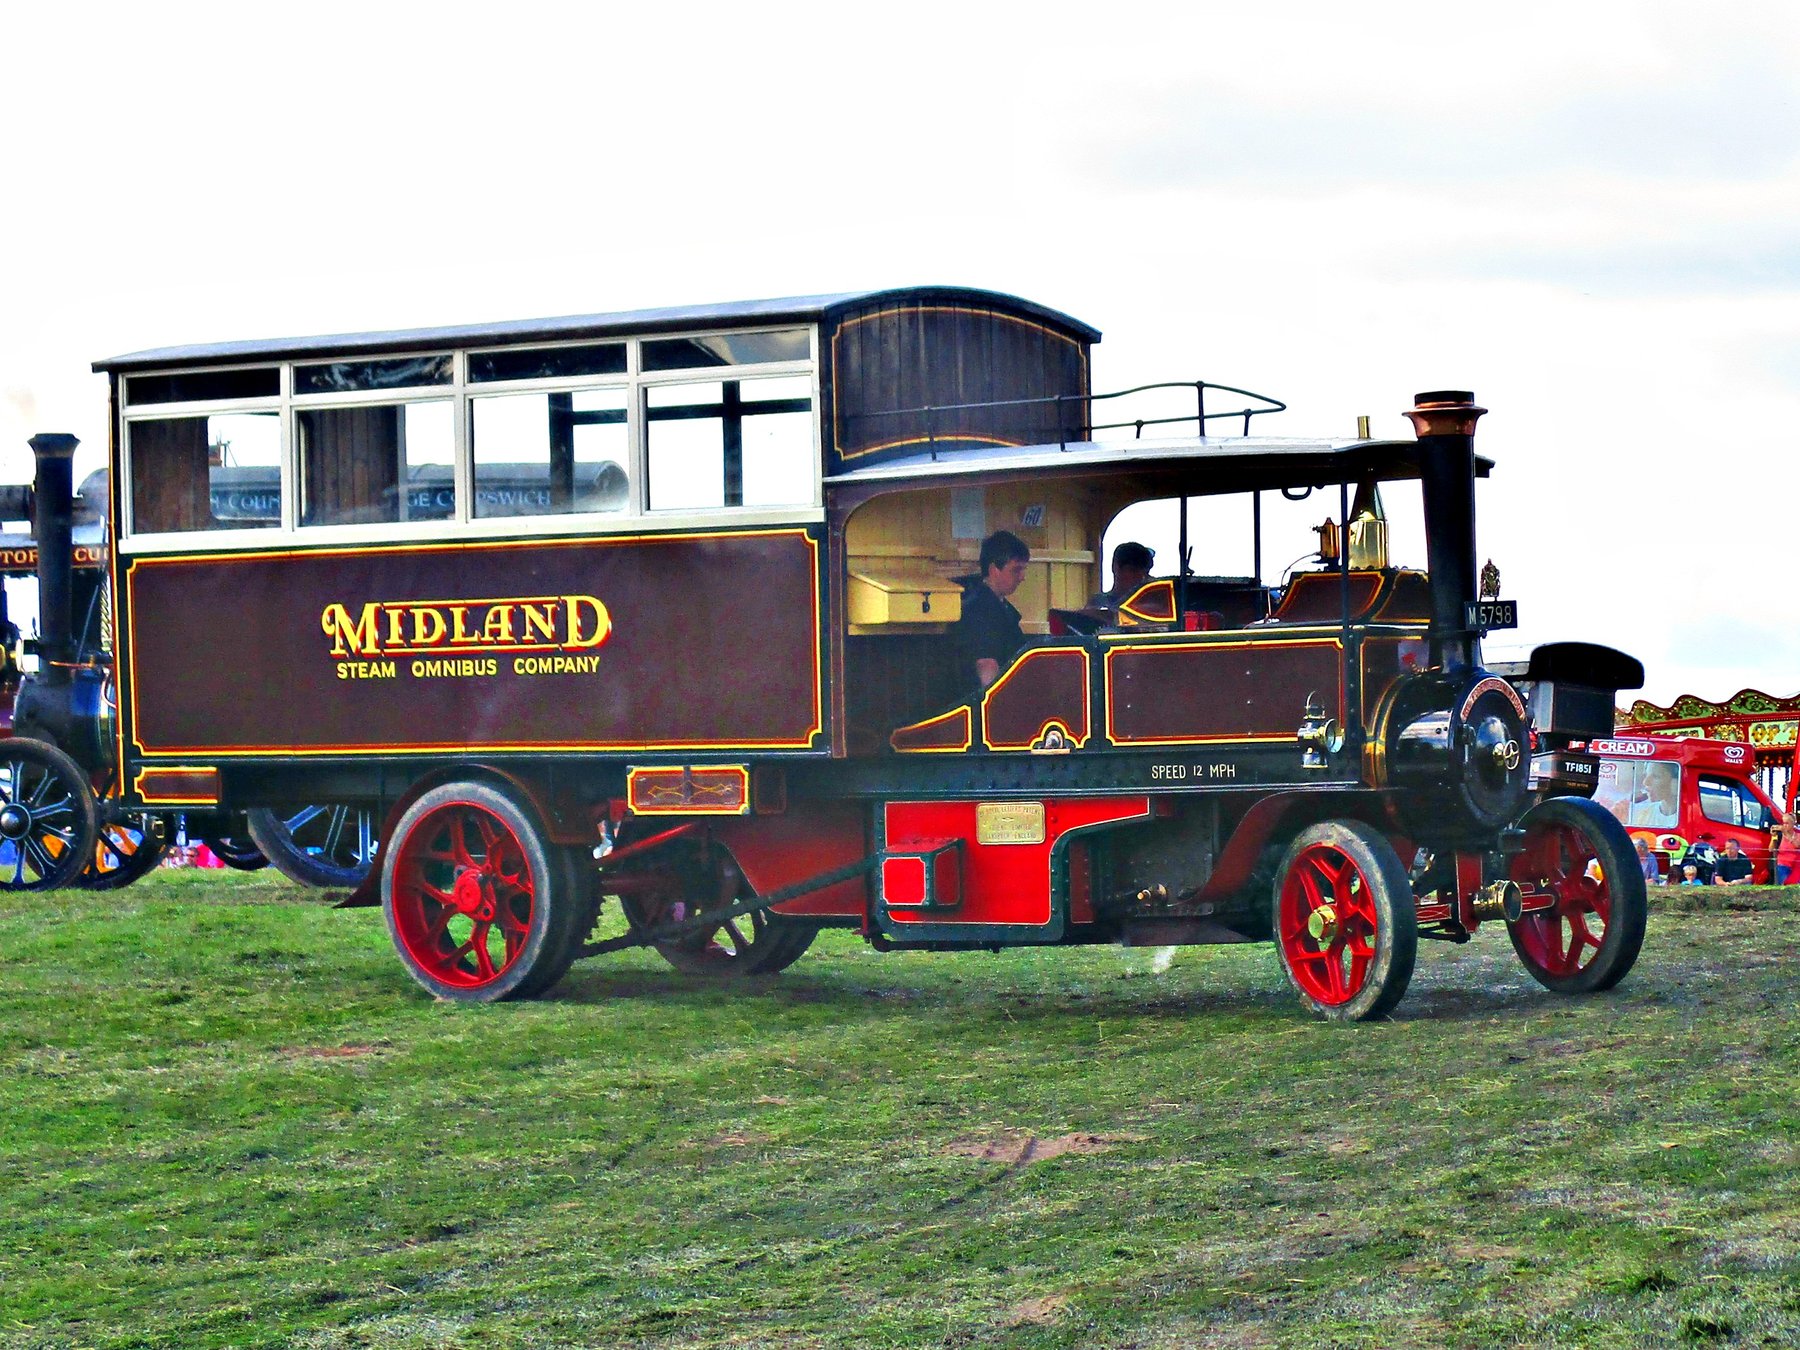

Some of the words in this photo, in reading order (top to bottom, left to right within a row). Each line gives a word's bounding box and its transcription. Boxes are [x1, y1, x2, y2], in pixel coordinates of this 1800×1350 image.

[1468, 606, 1477, 625] M
[1480, 605, 1512, 625] 5798
[321, 595, 612, 656] MIDLAND
[337, 661, 396, 679] STEAM
[411, 659, 497, 678] OMNIBUS
[513, 656, 600, 675] COMPANY
[1598, 741, 1648, 754] CREAM
[1151, 764, 1186, 779] SPEED
[1193, 765, 1203, 776] 12
[1209, 763, 1236, 778] MPH
[1565, 762, 1592, 774] TF1851
